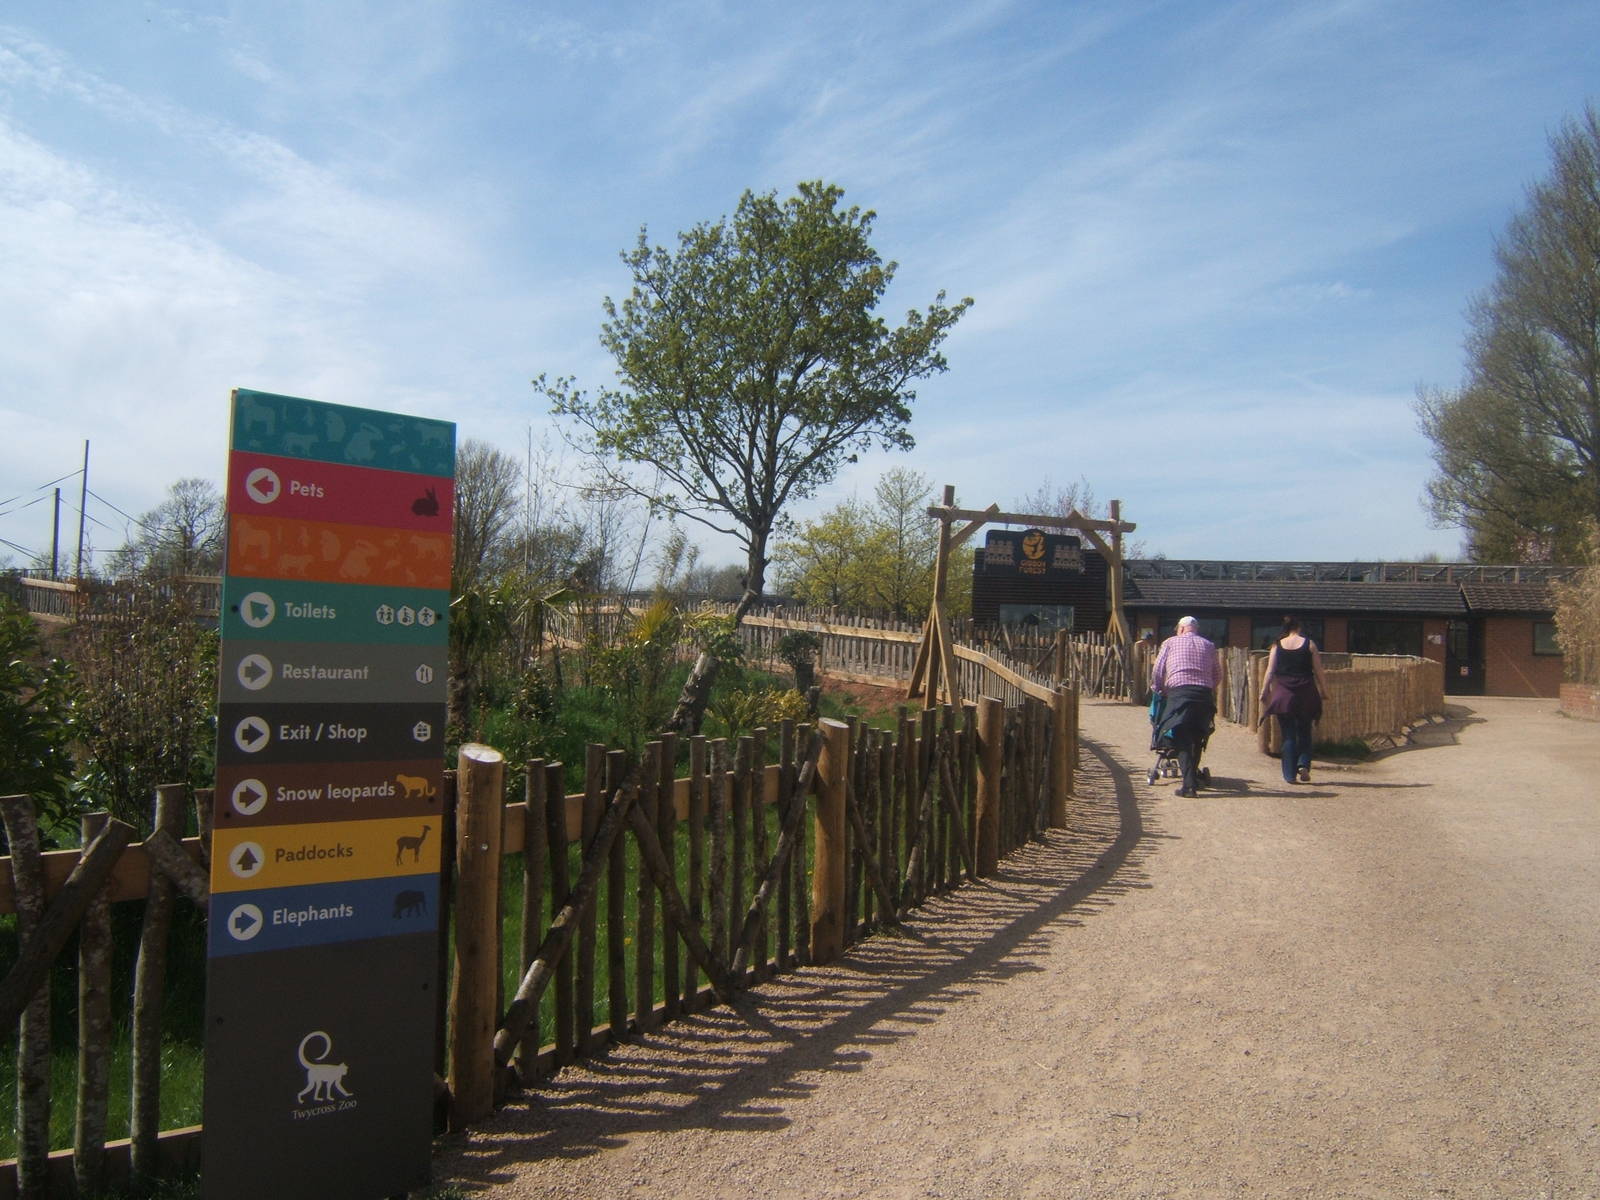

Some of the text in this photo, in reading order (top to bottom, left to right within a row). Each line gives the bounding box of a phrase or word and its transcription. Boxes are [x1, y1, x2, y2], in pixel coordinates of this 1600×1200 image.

[289, 480, 325, 499] Pets
[284, 602, 337, 620] Toilets
[282, 664, 369, 681] Restaurant
[279, 723, 368, 743] Exit / Shop
[276, 781, 396, 803] Snow leopards
[275, 843, 354, 864] Paddocks
[272, 904, 354, 926] Elephants
[292, 1100, 357, 1119] Twycross Zoo
